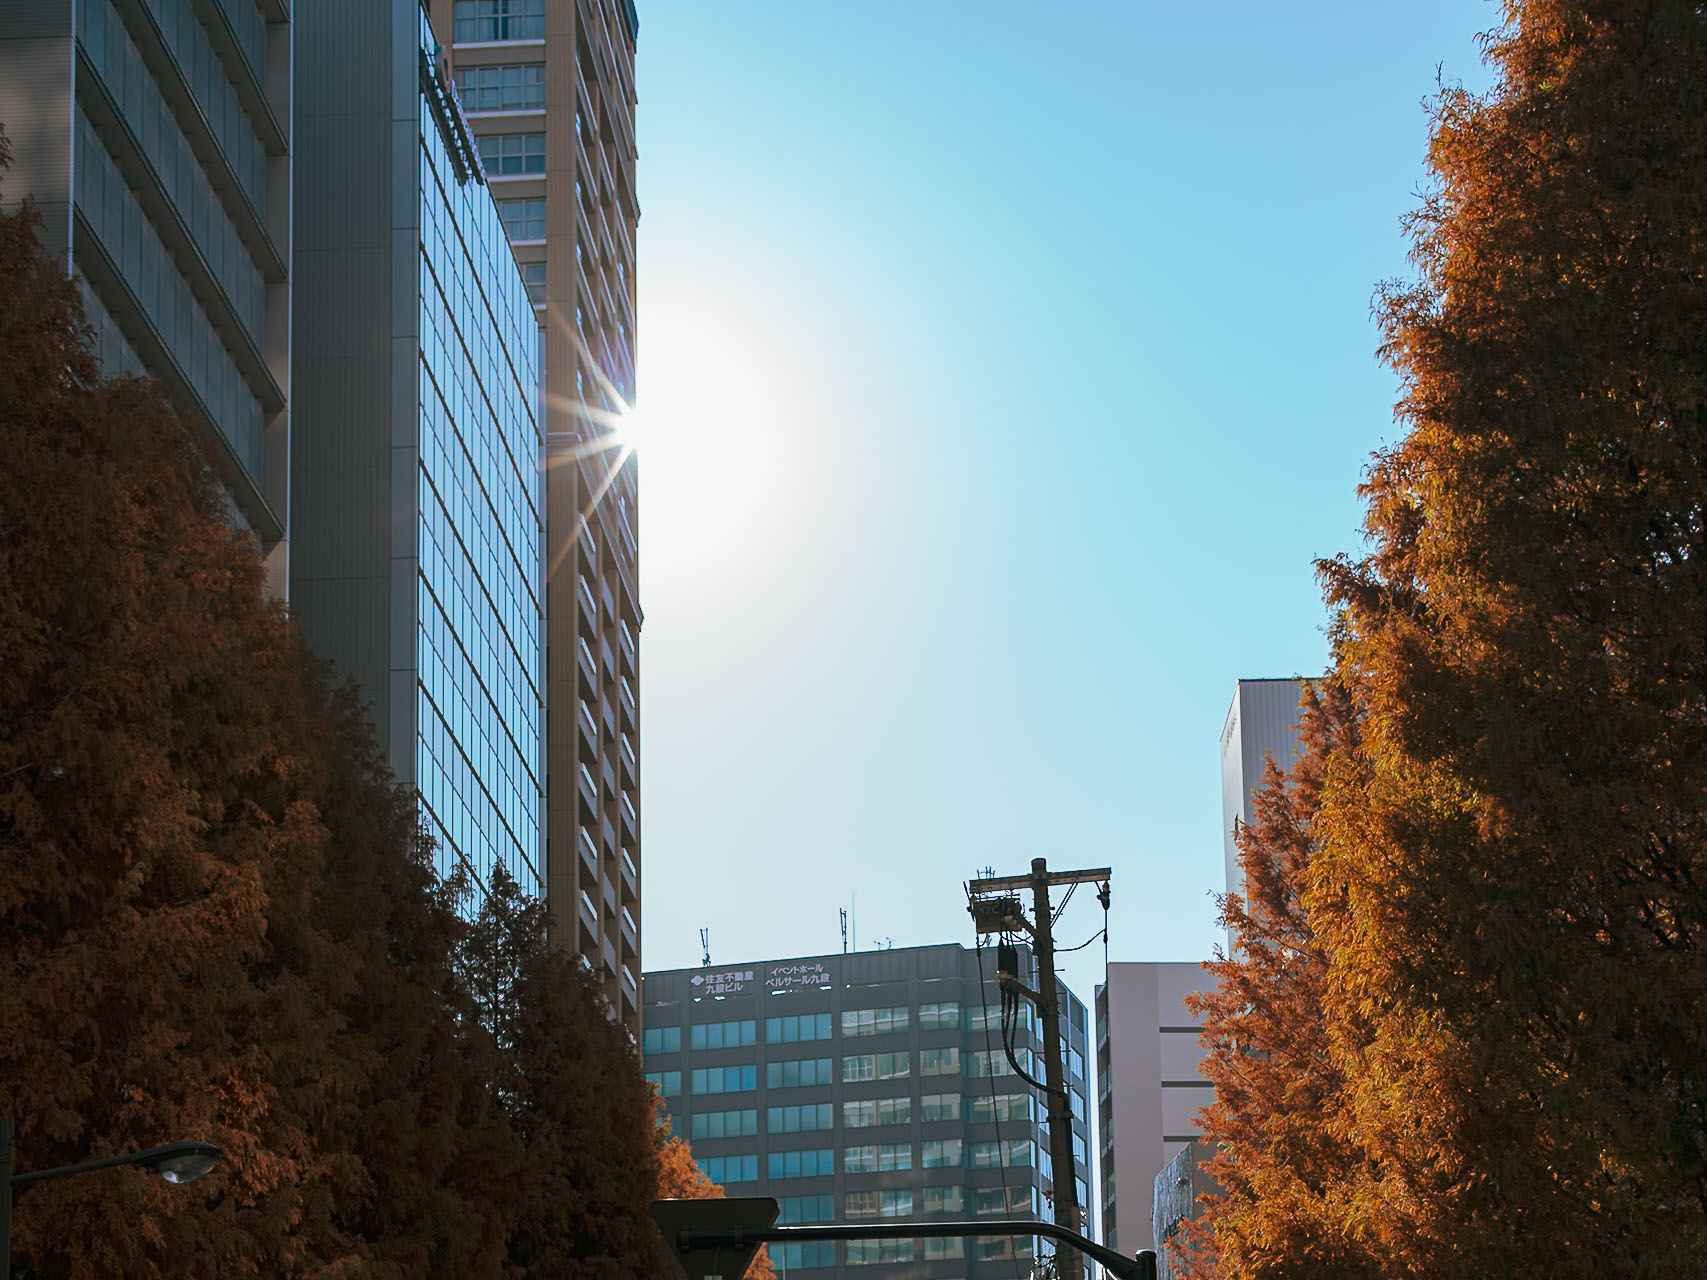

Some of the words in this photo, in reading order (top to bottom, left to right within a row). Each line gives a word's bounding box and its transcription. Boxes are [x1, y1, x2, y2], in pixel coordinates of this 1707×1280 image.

[705, 971, 754, 984] 住友不動産
[765, 973, 830, 987] ベルサール九段
[705, 982, 743, 994] 九段ビル
